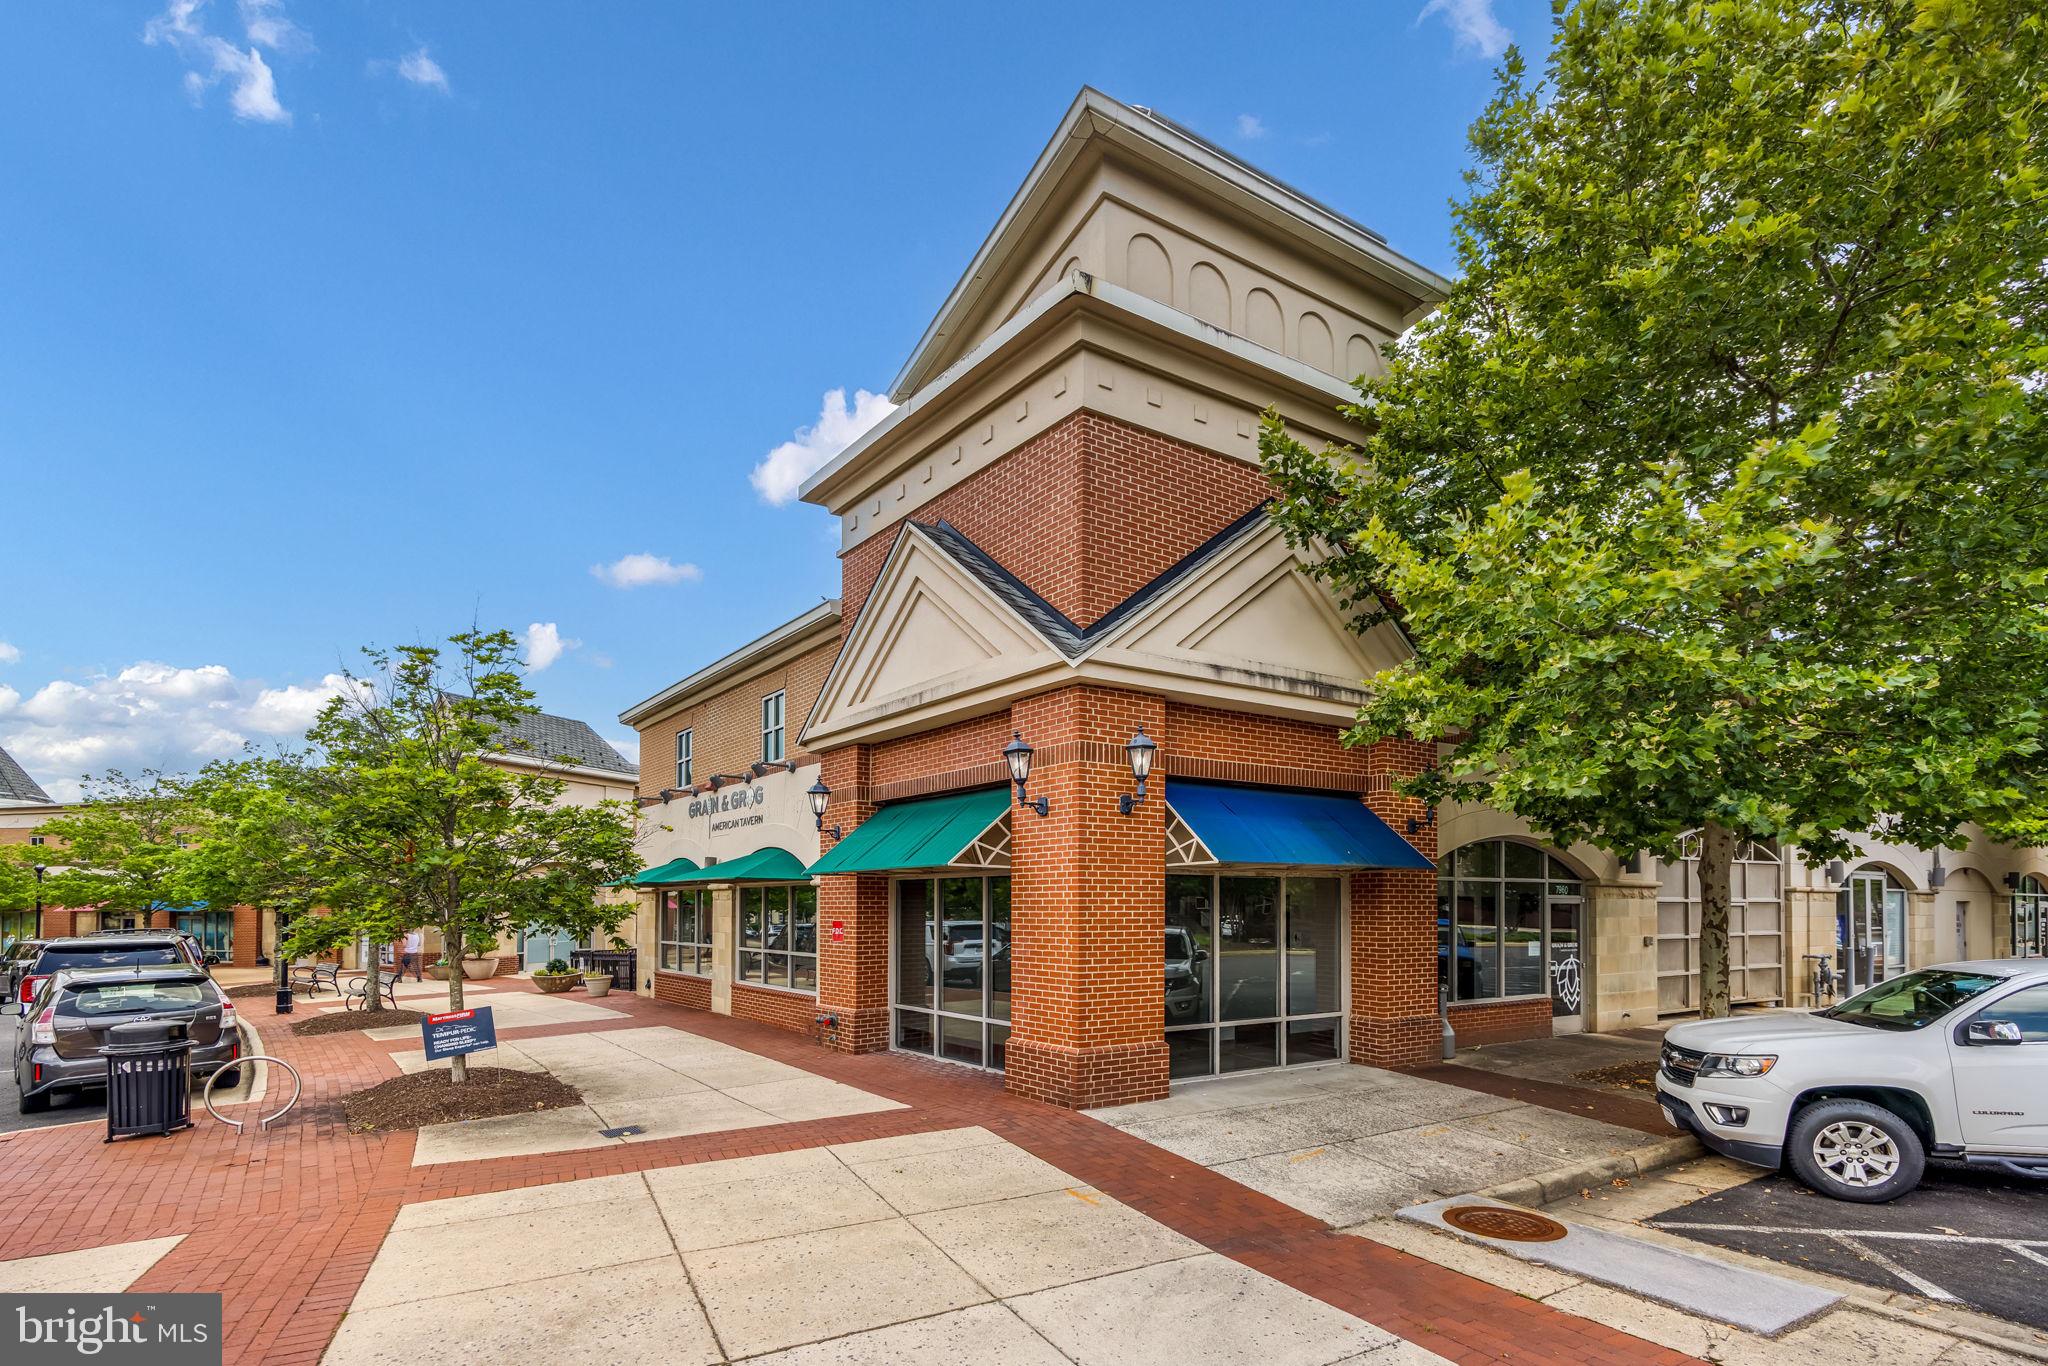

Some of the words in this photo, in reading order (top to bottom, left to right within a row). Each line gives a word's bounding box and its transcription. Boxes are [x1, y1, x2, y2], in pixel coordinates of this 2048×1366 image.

[688, 796, 719, 819] GRAIN
[721, 795, 729, 811] &
[712, 819, 740, 832] AMERICAN
[740, 815, 764, 827] TAVERN
[1555, 885, 1569, 894] 7960
